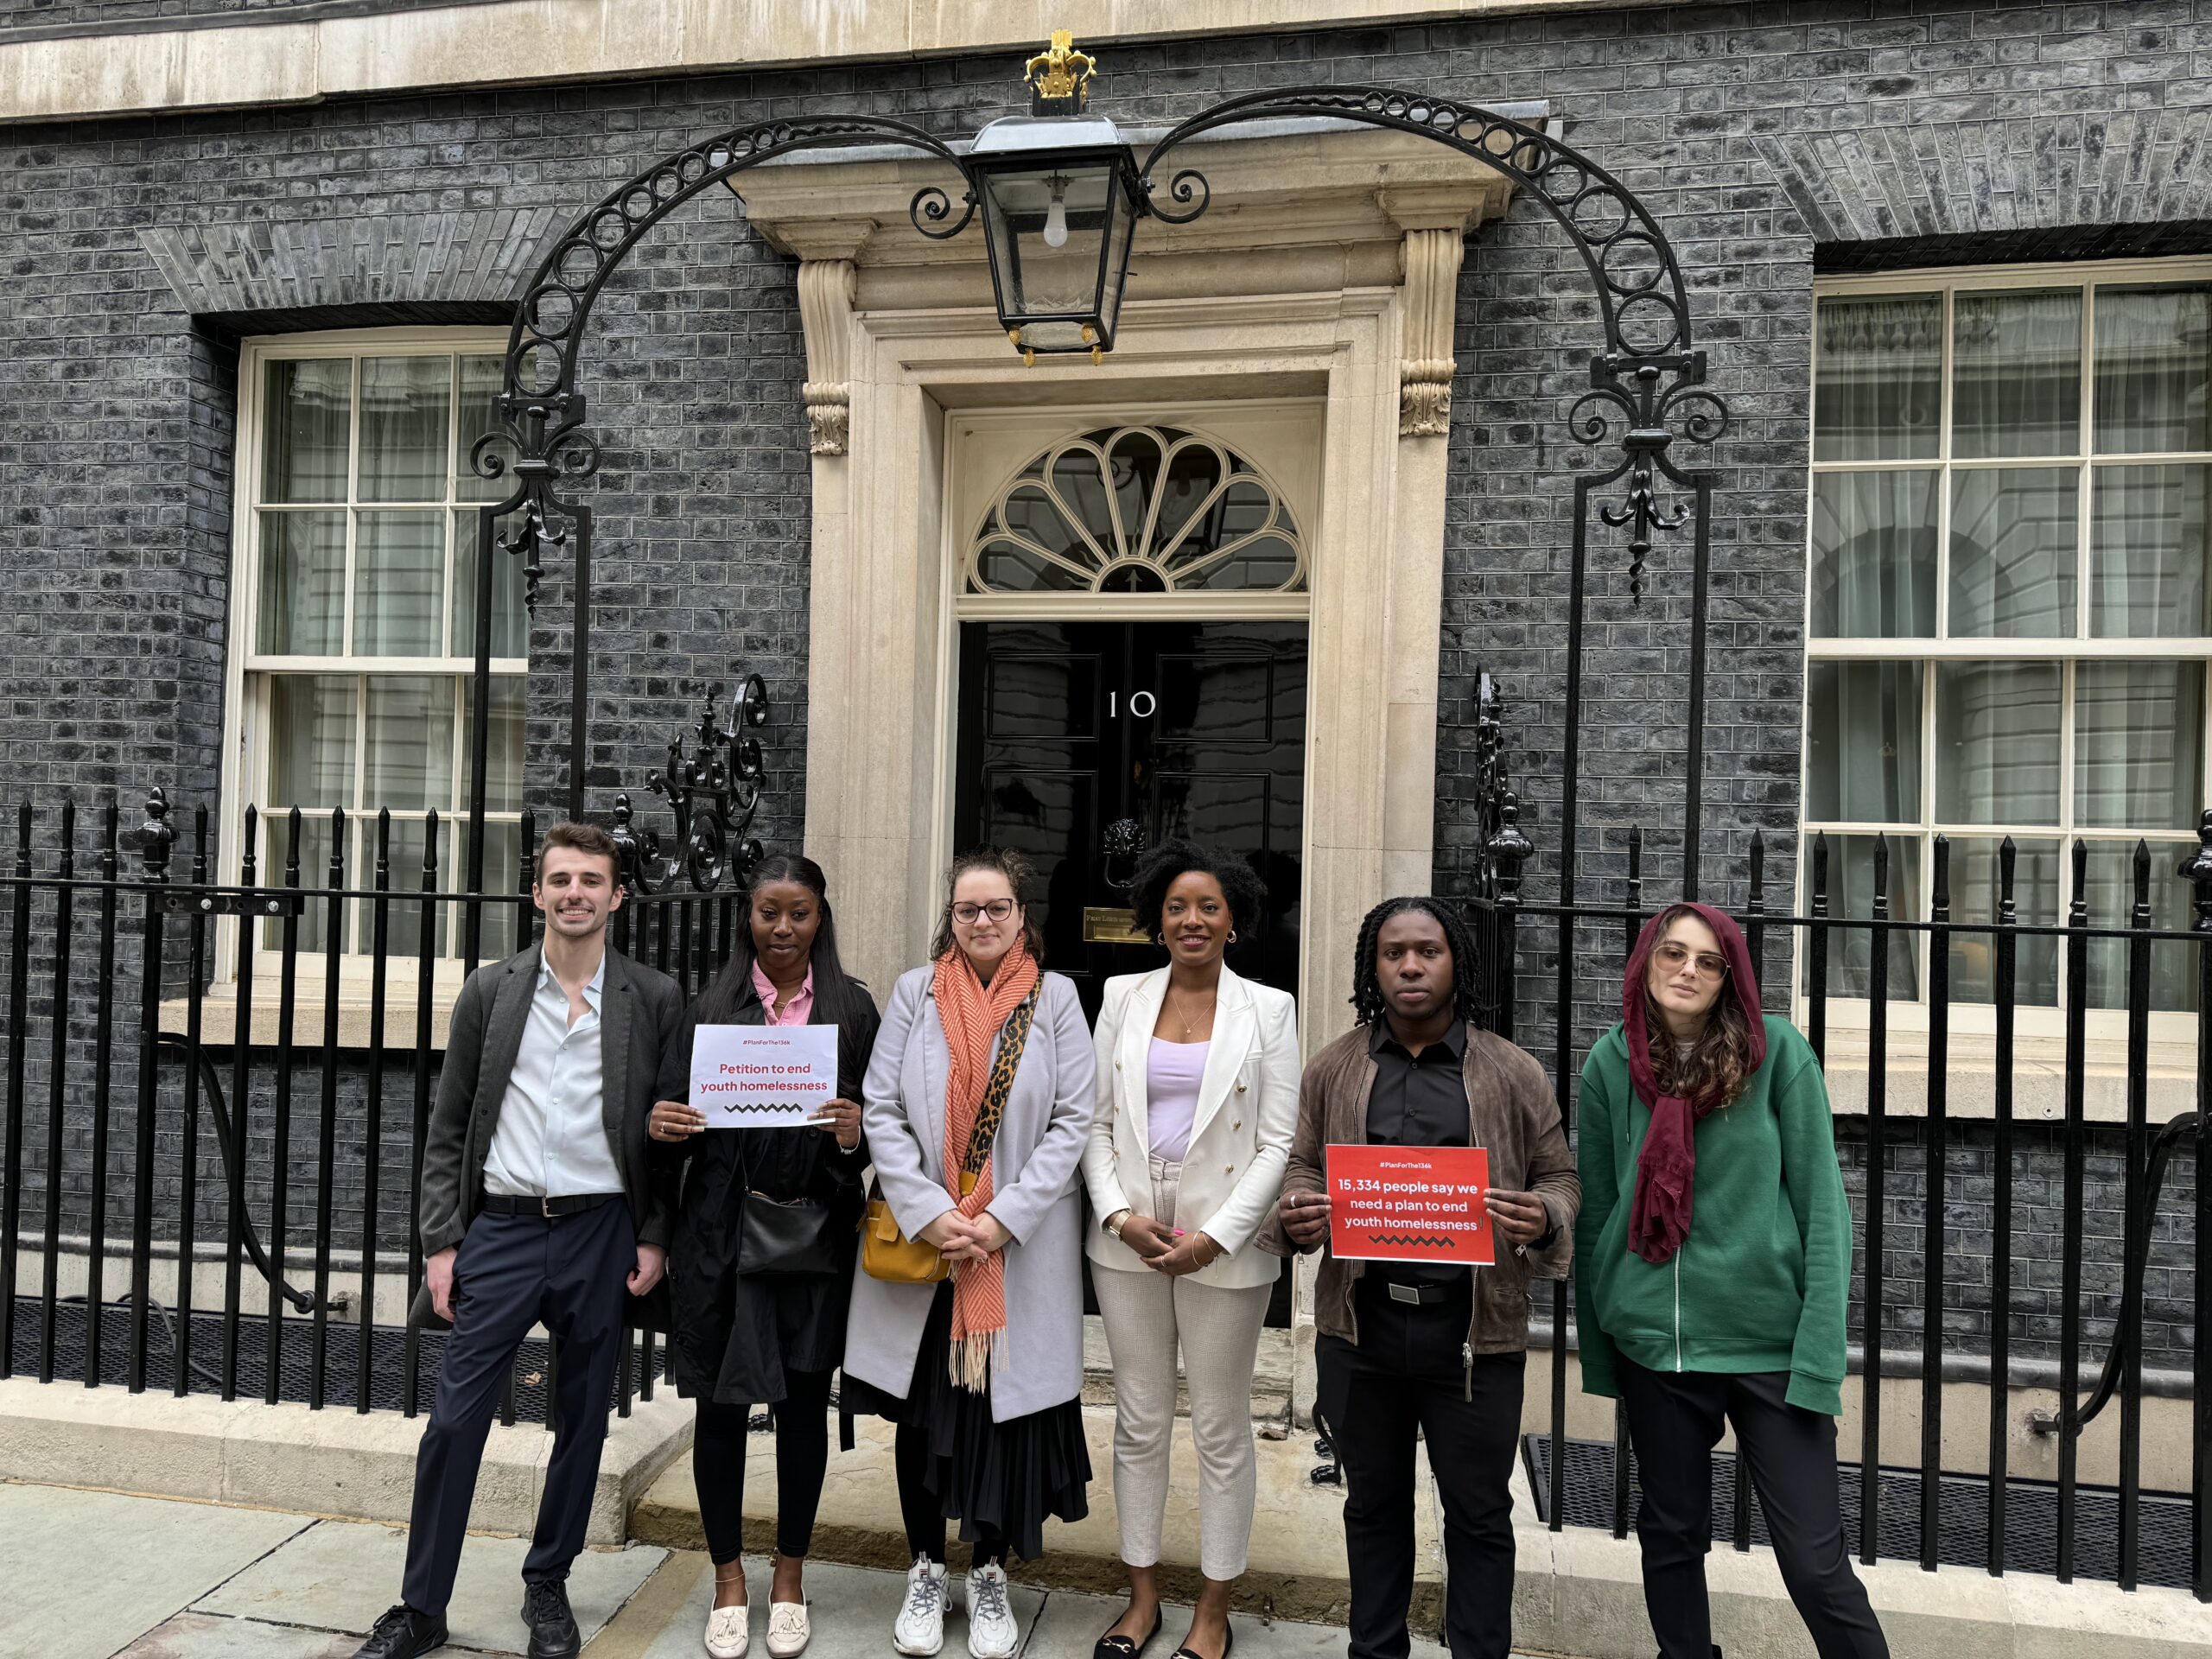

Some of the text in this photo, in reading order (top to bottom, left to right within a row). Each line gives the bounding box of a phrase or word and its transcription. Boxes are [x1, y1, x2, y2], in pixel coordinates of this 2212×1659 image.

[1110, 691, 1156, 717] 10
[720, 1063, 810, 1074] Petition to end
[701, 1081, 827, 1093] youth homelessness
[1338, 1179, 1478, 1196] 15,334 people say we
[1351, 1199, 1382, 1210] need
[1395, 1200, 1422, 1212] plan
[1425, 1203, 1440, 1211] to
[1442, 1202, 1468, 1212] end
[1344, 1217, 1477, 1230] youth homelessness
